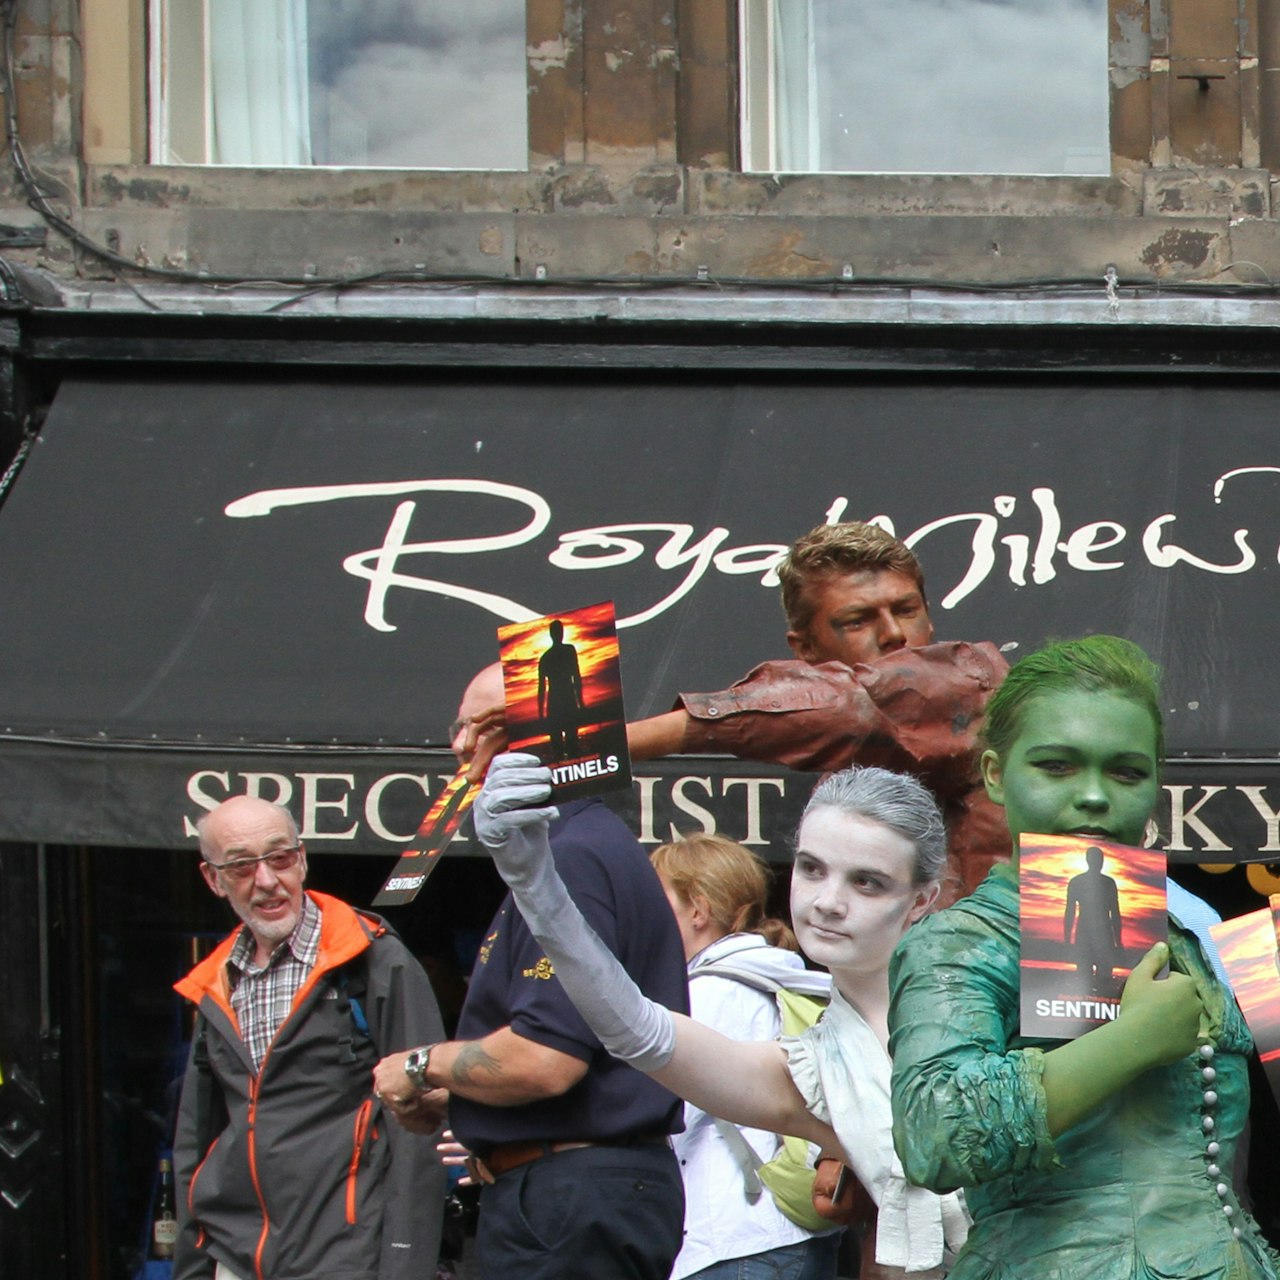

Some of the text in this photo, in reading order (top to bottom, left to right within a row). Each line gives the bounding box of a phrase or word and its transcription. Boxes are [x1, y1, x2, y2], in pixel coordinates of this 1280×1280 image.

[551, 755, 619, 785] NTINELS
[184, 769, 786, 848] SPECIST
[385, 874, 425, 890] SENTINELS
[1036, 999, 1121, 1020] SENTIN
